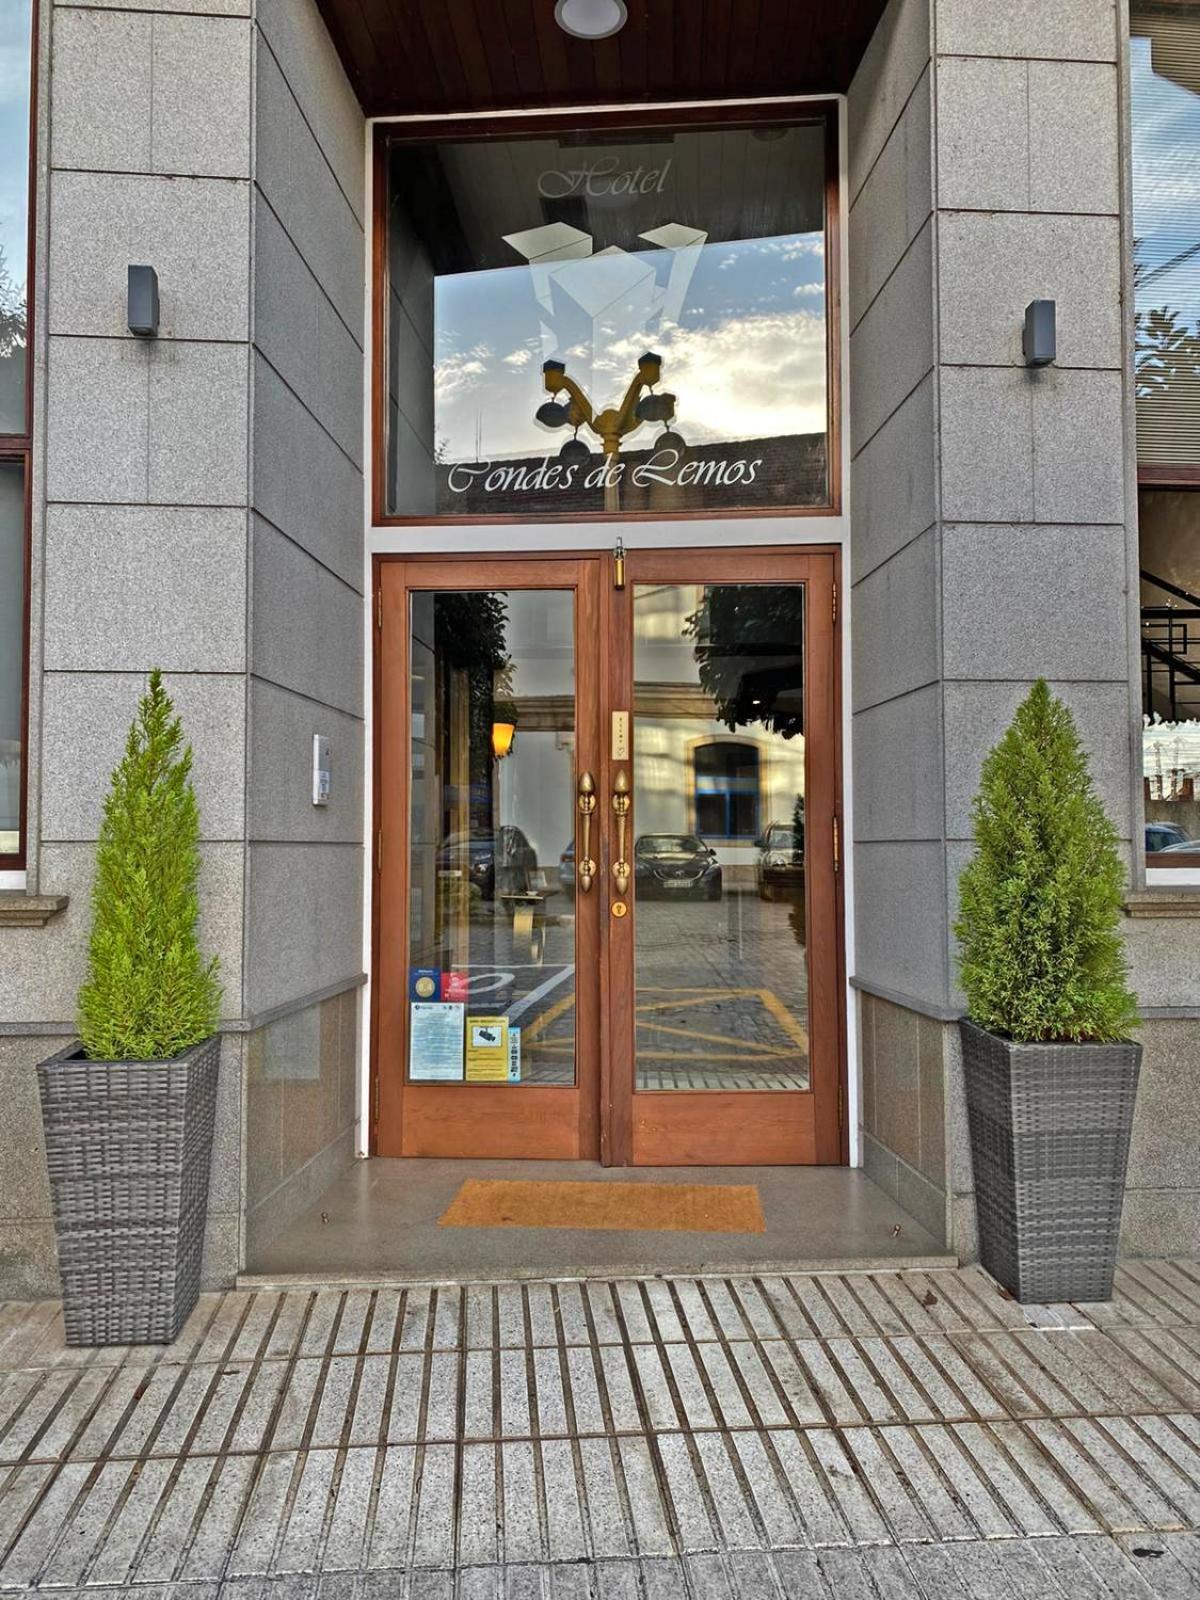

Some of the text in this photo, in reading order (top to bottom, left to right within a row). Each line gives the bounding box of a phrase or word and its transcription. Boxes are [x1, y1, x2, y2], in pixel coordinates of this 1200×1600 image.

[537, 156, 672, 198] Hotel
[447, 448, 762, 492] Condes de Lemos
